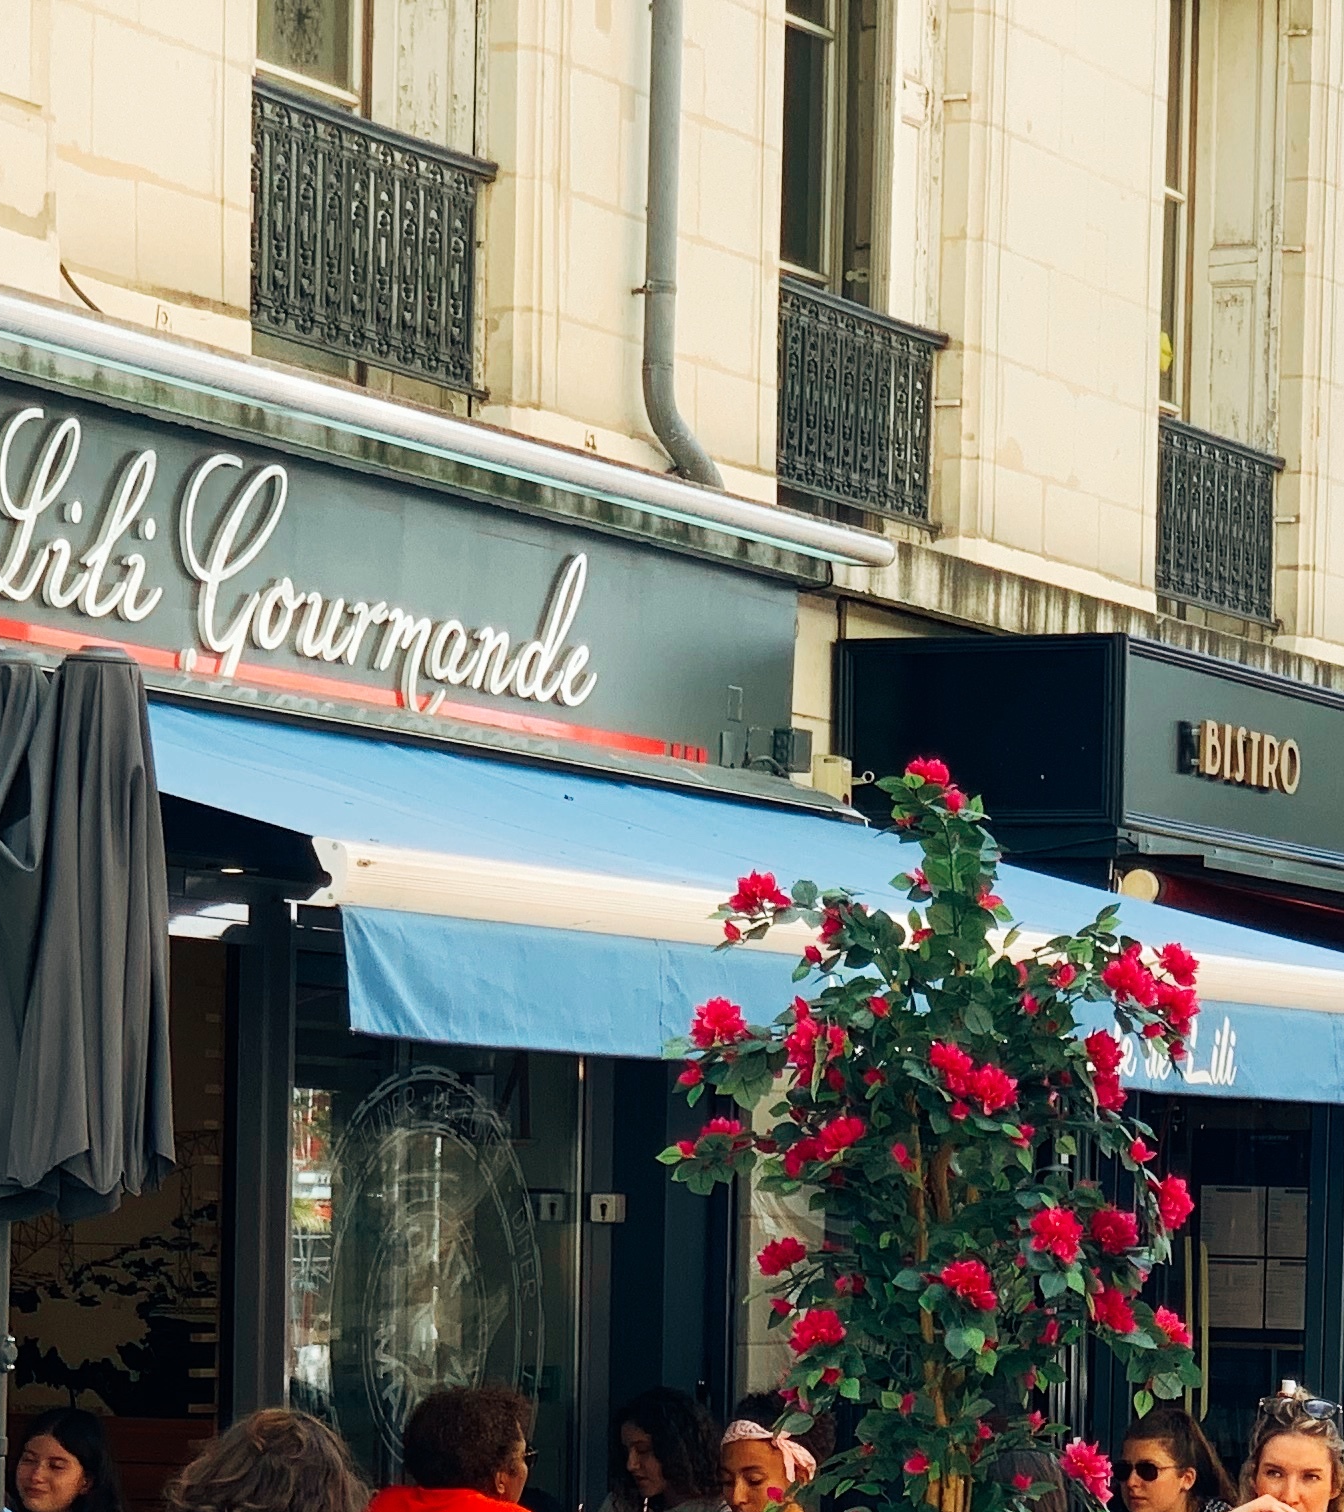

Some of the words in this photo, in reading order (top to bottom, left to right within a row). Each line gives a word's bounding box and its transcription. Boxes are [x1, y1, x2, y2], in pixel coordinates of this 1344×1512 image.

[181, 452, 597, 716] Gourmande
[1199, 719, 1302, 795] BISTRO
[1183, 1015, 1238, 1087] Lili
